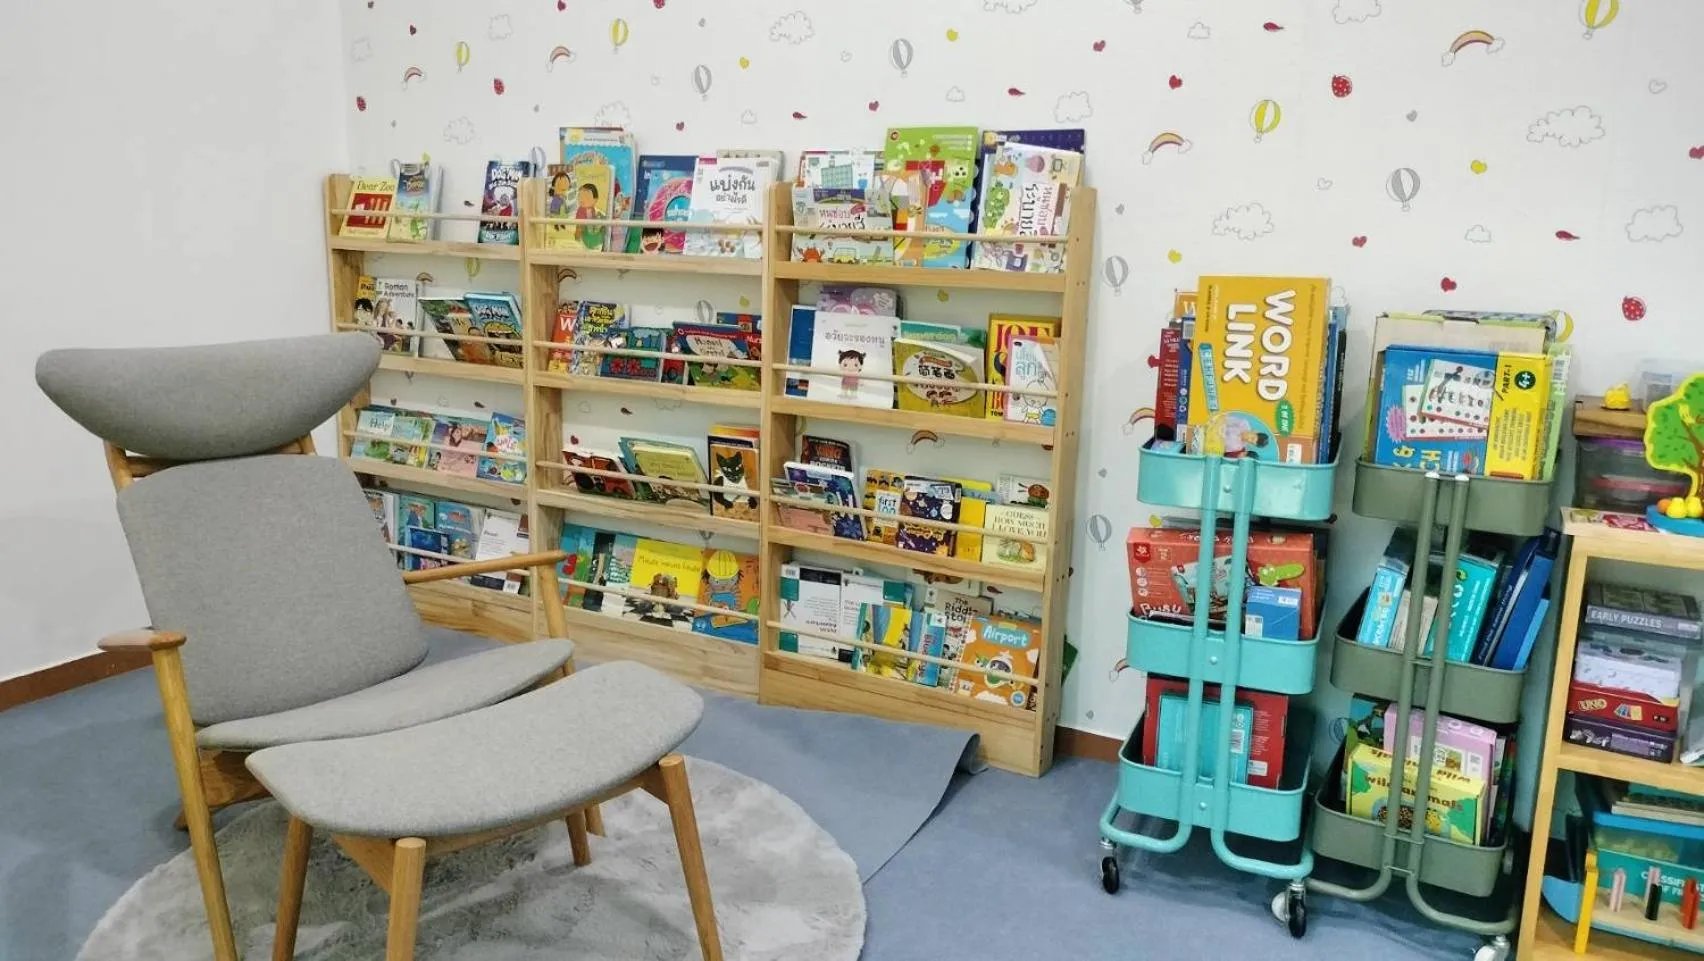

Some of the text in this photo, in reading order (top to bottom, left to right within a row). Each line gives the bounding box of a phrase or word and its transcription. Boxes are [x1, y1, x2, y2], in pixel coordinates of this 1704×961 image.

[357, 180, 379, 190] Dear
[381, 182, 395, 191] Zoo
[710, 174, 755, 191] แบ่งกัน
[1222, 302, 1258, 384] LINK
[1258, 289, 1297, 402] WORD
[1518, 371, 1531, 388] 4+
[994, 516, 1015, 524] HOW
[954, 597, 968, 605] The
[1590, 609, 1619, 624] EARLY
[1620, 615, 1664, 630] PUZZLES
[982, 624, 1030, 649] Airport
